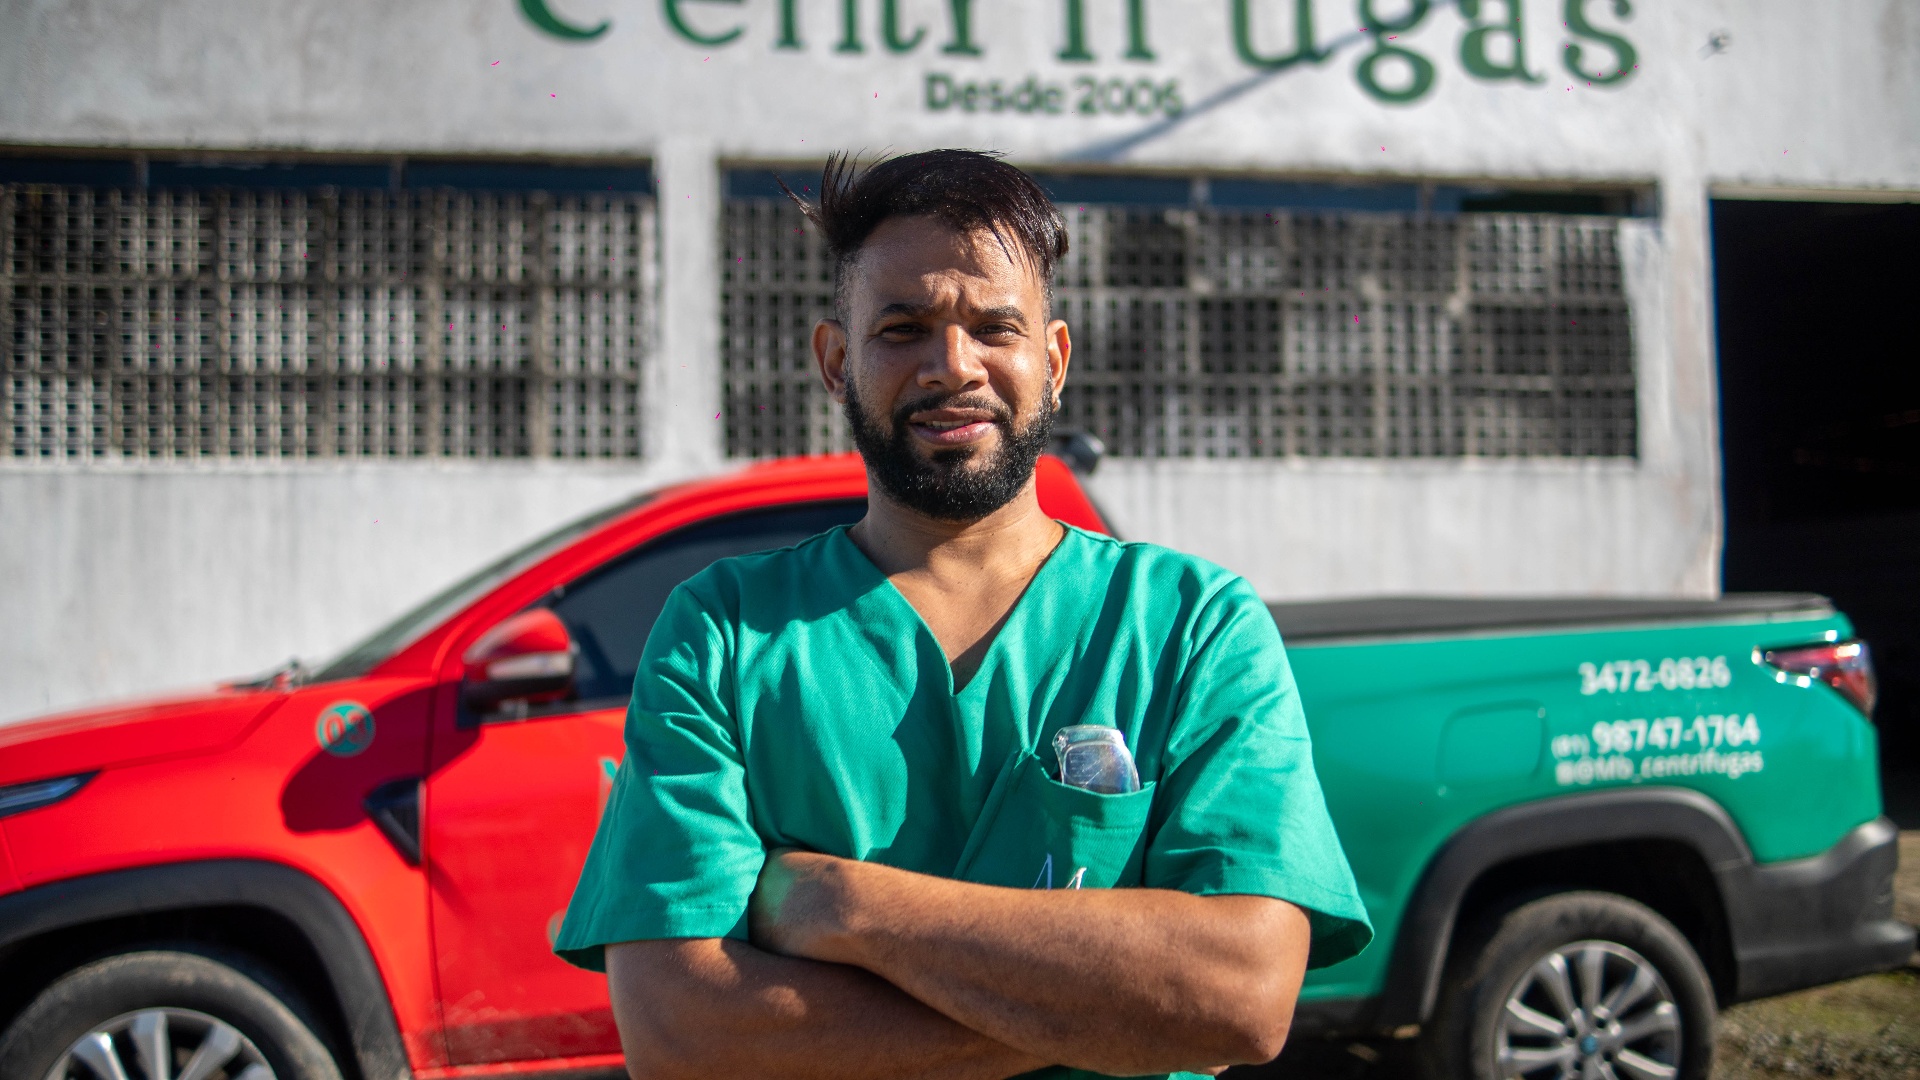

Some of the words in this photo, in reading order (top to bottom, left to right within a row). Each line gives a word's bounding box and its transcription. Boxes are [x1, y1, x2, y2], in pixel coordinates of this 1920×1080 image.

[926, 74, 1063, 113] Desde
[1075, 77, 1184, 117] 2006
[1579, 656, 1731, 694] 3472-0826
[1592, 713, 1761, 752] 98747-1764
